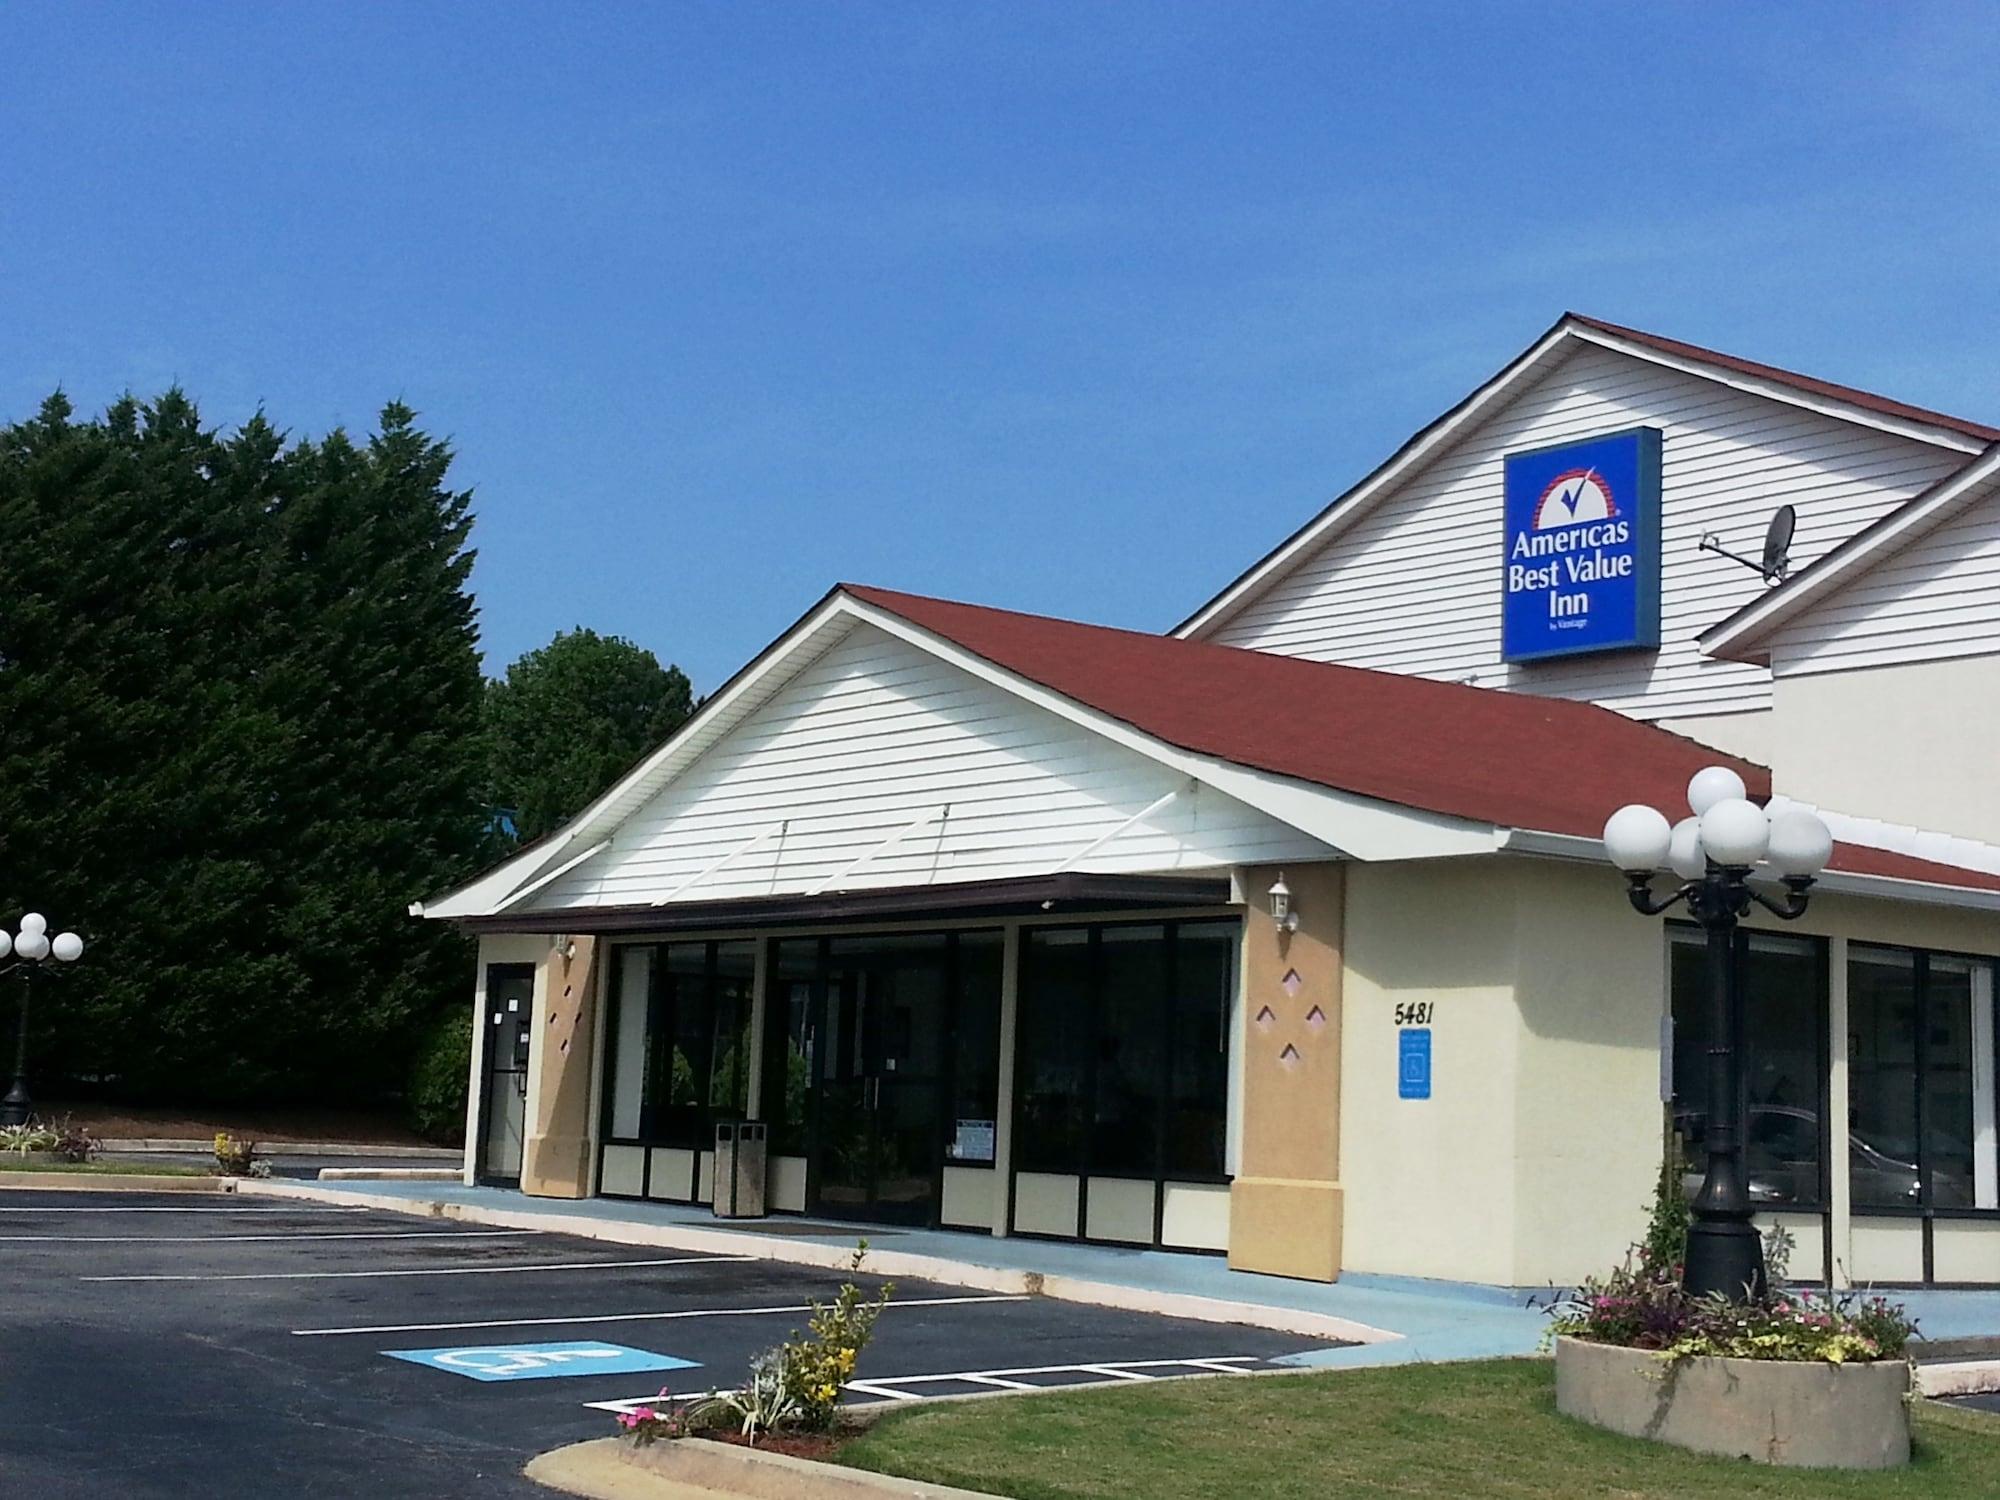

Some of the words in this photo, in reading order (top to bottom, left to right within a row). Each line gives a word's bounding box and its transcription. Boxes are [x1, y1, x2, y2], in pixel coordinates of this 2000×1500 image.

[1511, 521, 1629, 560] Americas
[1509, 560, 1559, 593] Best
[1565, 549, 1633, 583] Value
[1550, 590, 1588, 618] Inn
[1395, 1002, 1434, 1025] 5481
